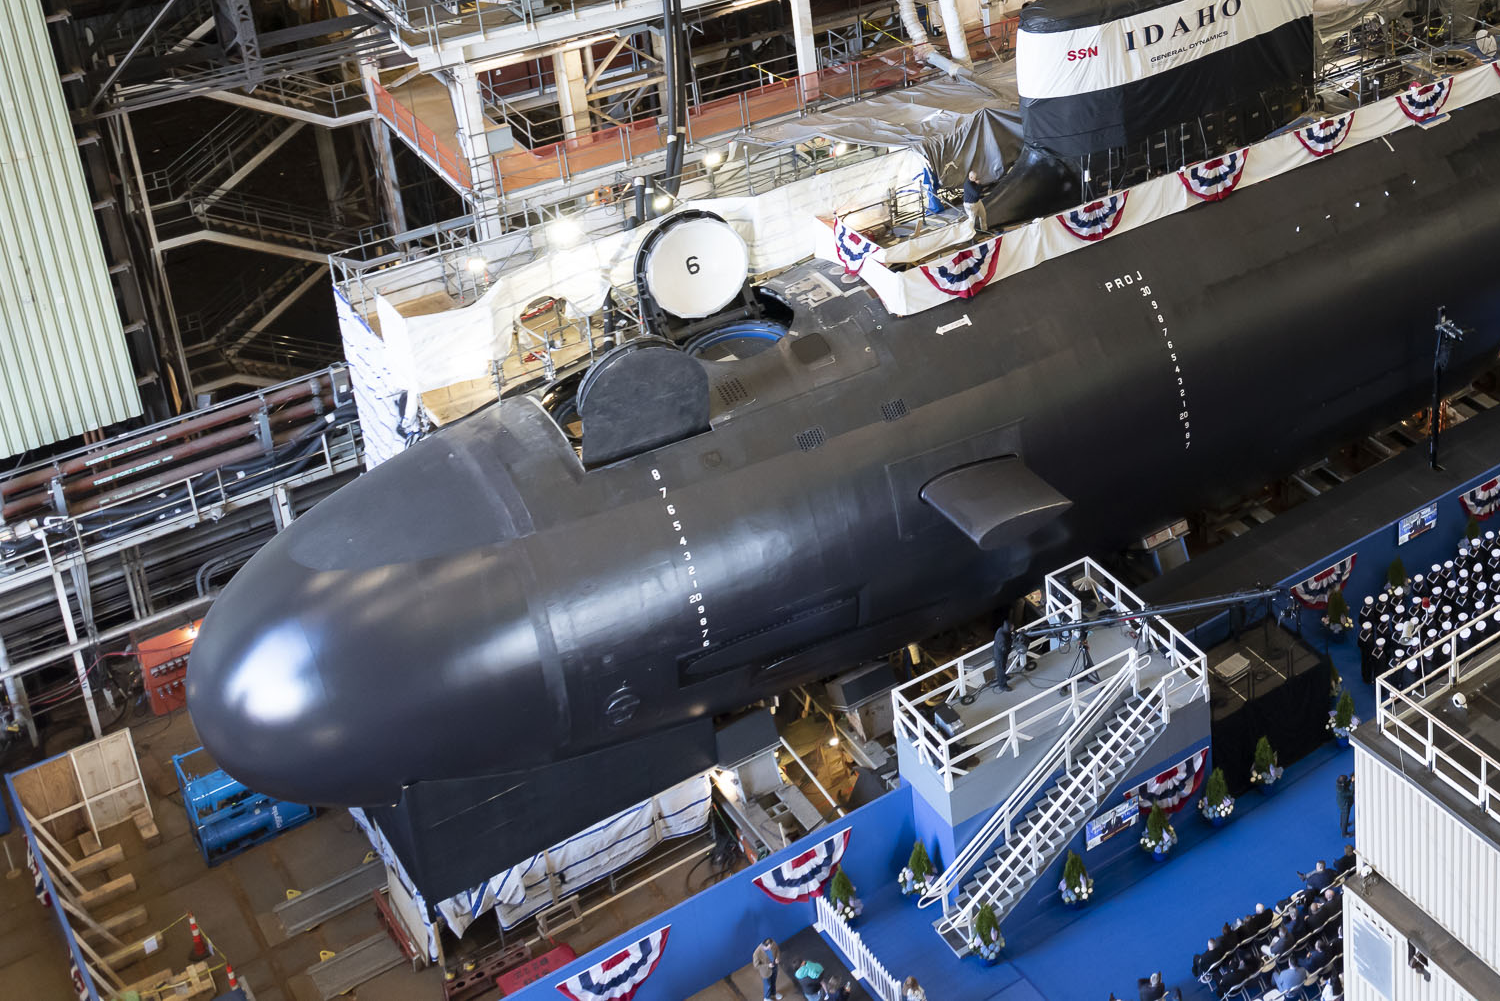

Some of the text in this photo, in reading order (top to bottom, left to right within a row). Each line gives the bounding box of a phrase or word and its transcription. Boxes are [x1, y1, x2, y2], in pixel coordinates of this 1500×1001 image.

[1150, 30, 1228, 63] GENERAL DYNAMICS
[1067, 46, 1098, 61] SSN
[686, 256, 700, 274] 6
[1104, 270, 1143, 292] PROJ
[1140, 286, 1151, 296] 30
[1152, 301, 1158, 309] 9
[1163, 328, 1167, 336] 7
[1171, 353, 1176, 361] 5
[1180, 411, 1188, 420] 20
[651, 469, 661, 480] 8
[659, 487, 666, 498] 7
[667, 505, 675, 515] 6
[673, 521, 681, 531] 5
[680, 536, 687, 545] 4
[684, 552, 691, 560] 3
[688, 566, 695, 575] 2
[690, 593, 702, 603] 20
[698, 605, 704, 613] 9
[702, 629, 708, 637] 7
